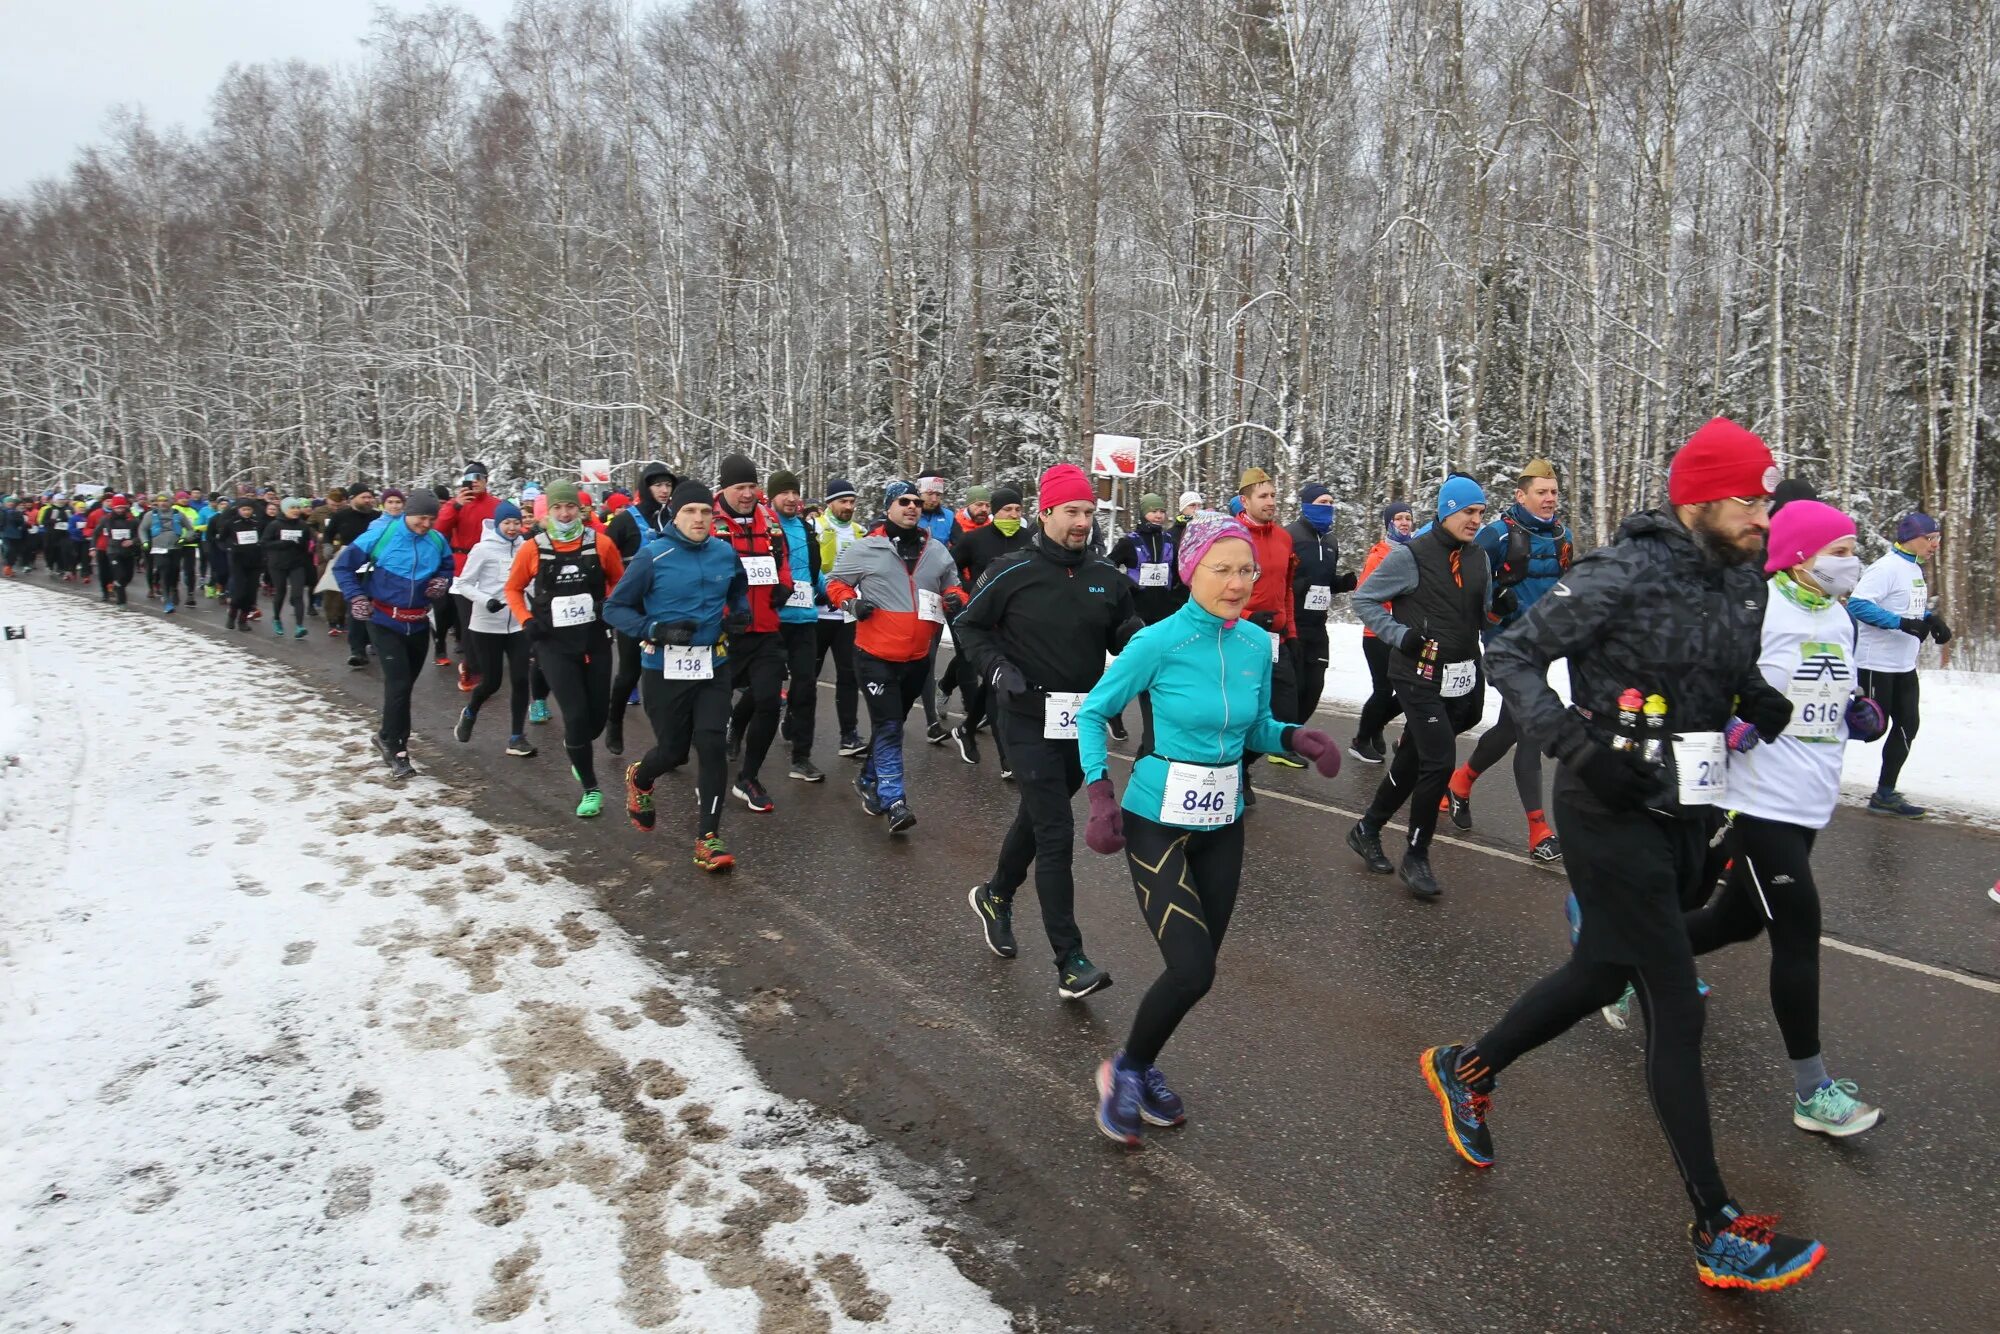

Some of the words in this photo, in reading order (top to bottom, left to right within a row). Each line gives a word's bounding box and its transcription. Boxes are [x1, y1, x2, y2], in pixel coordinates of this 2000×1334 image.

[750, 567, 772, 578] 369
[1150, 572, 1161, 581] 46
[562, 606, 586, 619] 154
[675, 658, 702, 672] 138
[1452, 674, 1472, 689] 795
[1803, 702, 1839, 723] 616
[1182, 789, 1225, 812] 846
